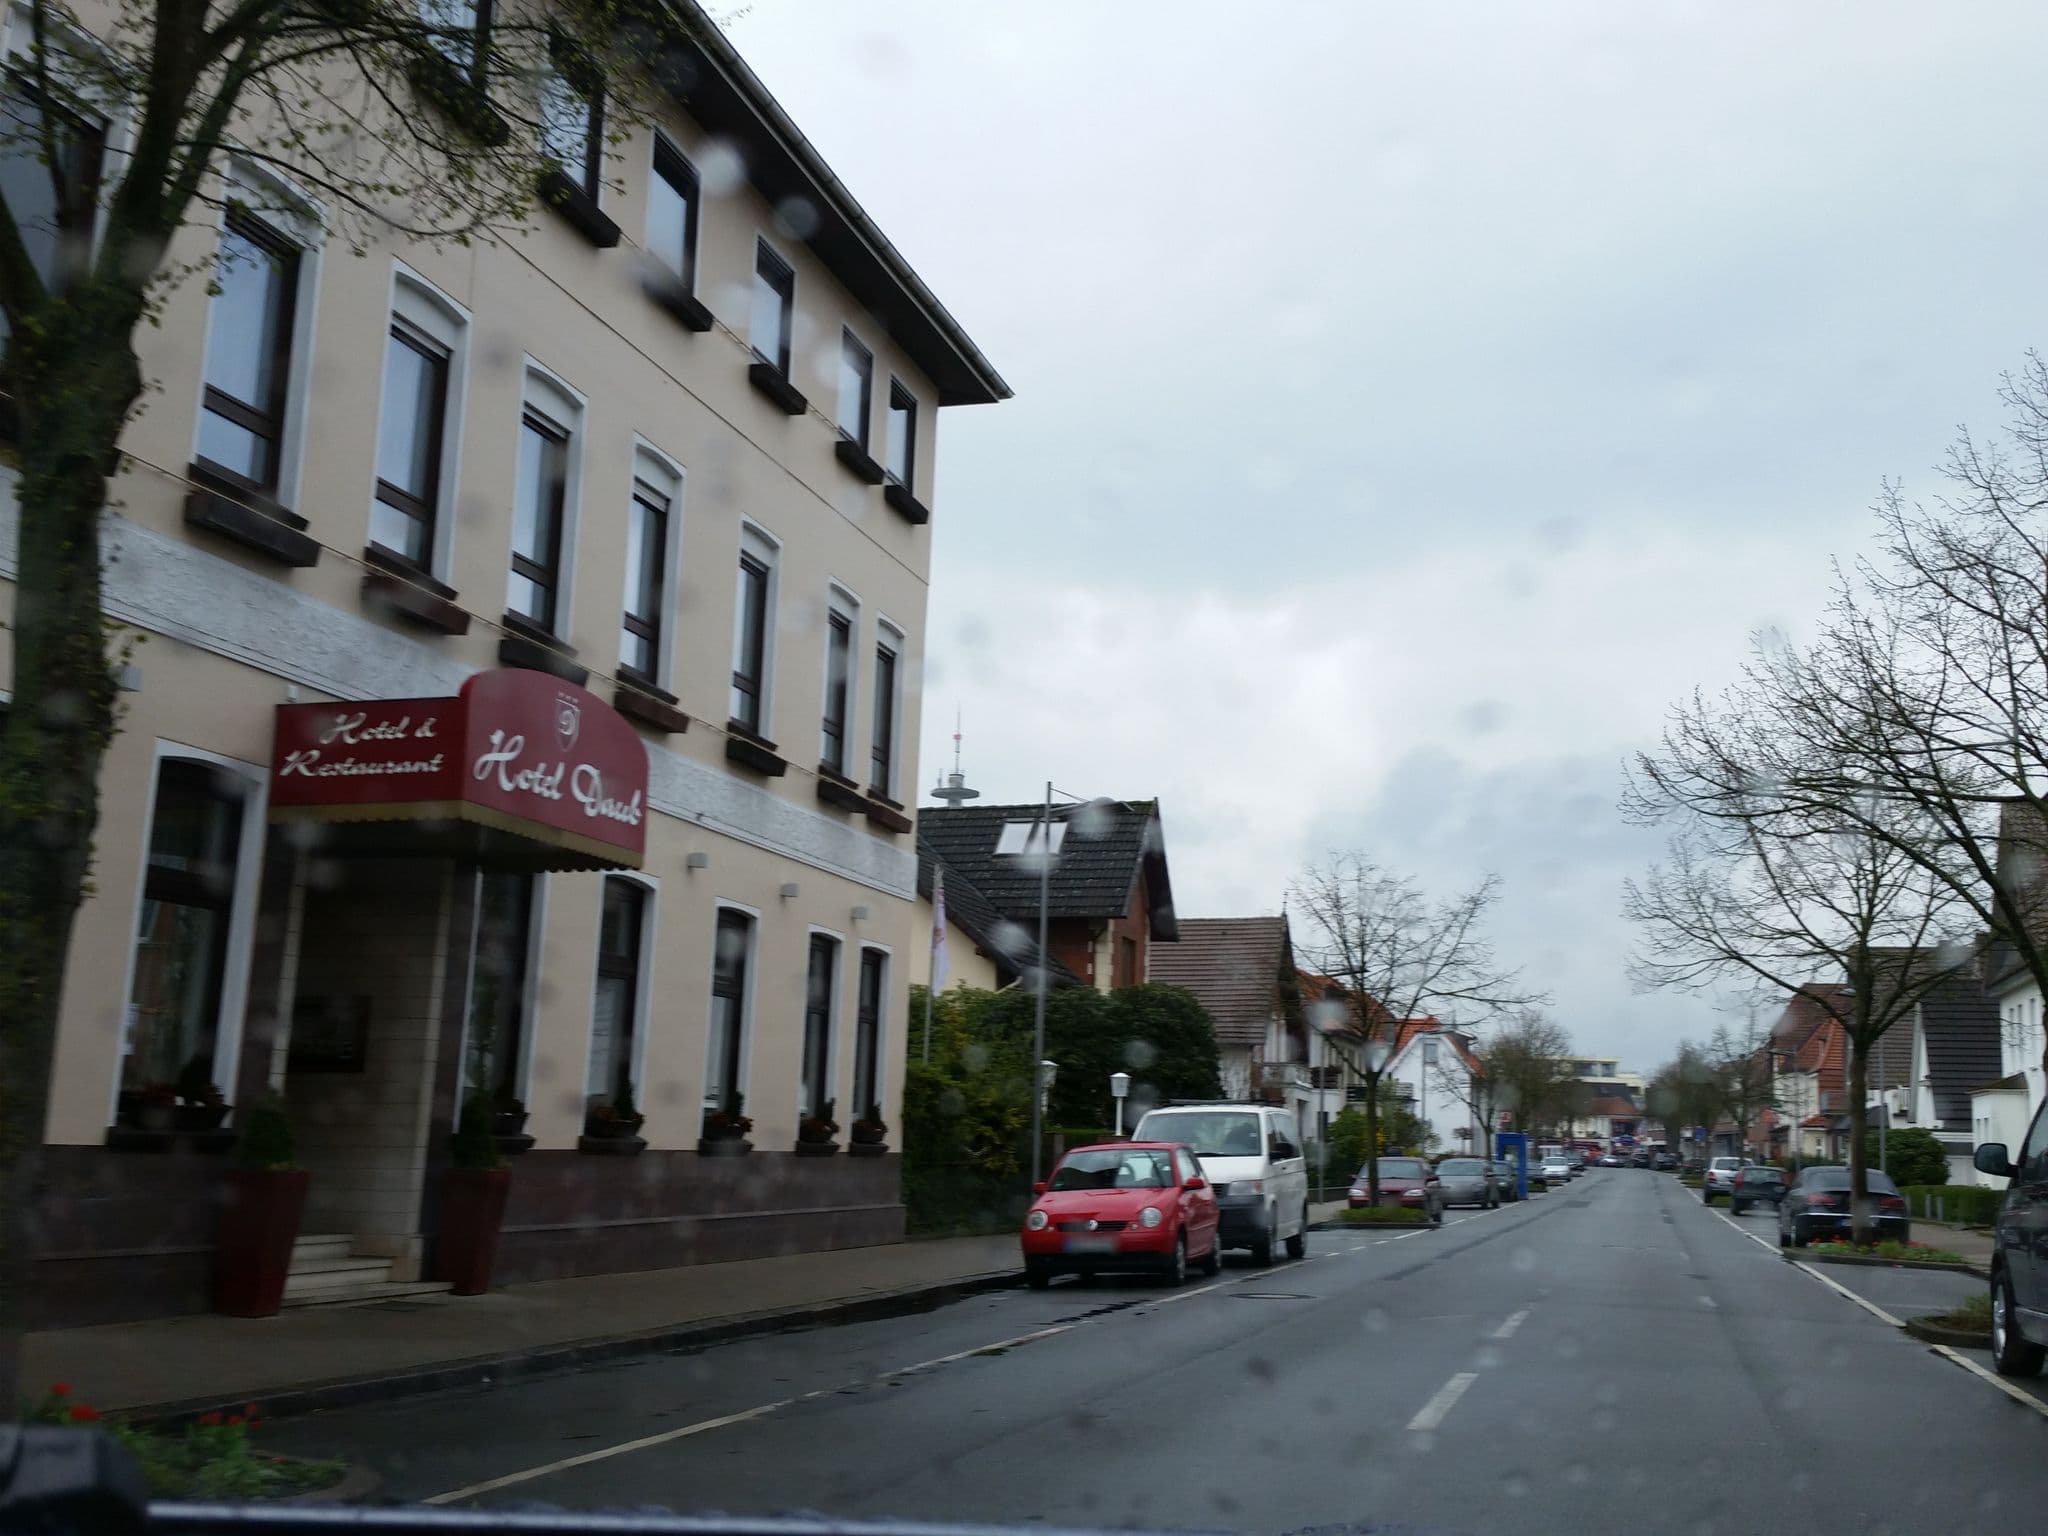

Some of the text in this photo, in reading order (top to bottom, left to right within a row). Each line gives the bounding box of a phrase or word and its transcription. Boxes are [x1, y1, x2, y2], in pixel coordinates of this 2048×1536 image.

[320, 711, 437, 745] Hotel &
[280, 749, 444, 777] Restaurant
[474, 729, 565, 800] Hotel
